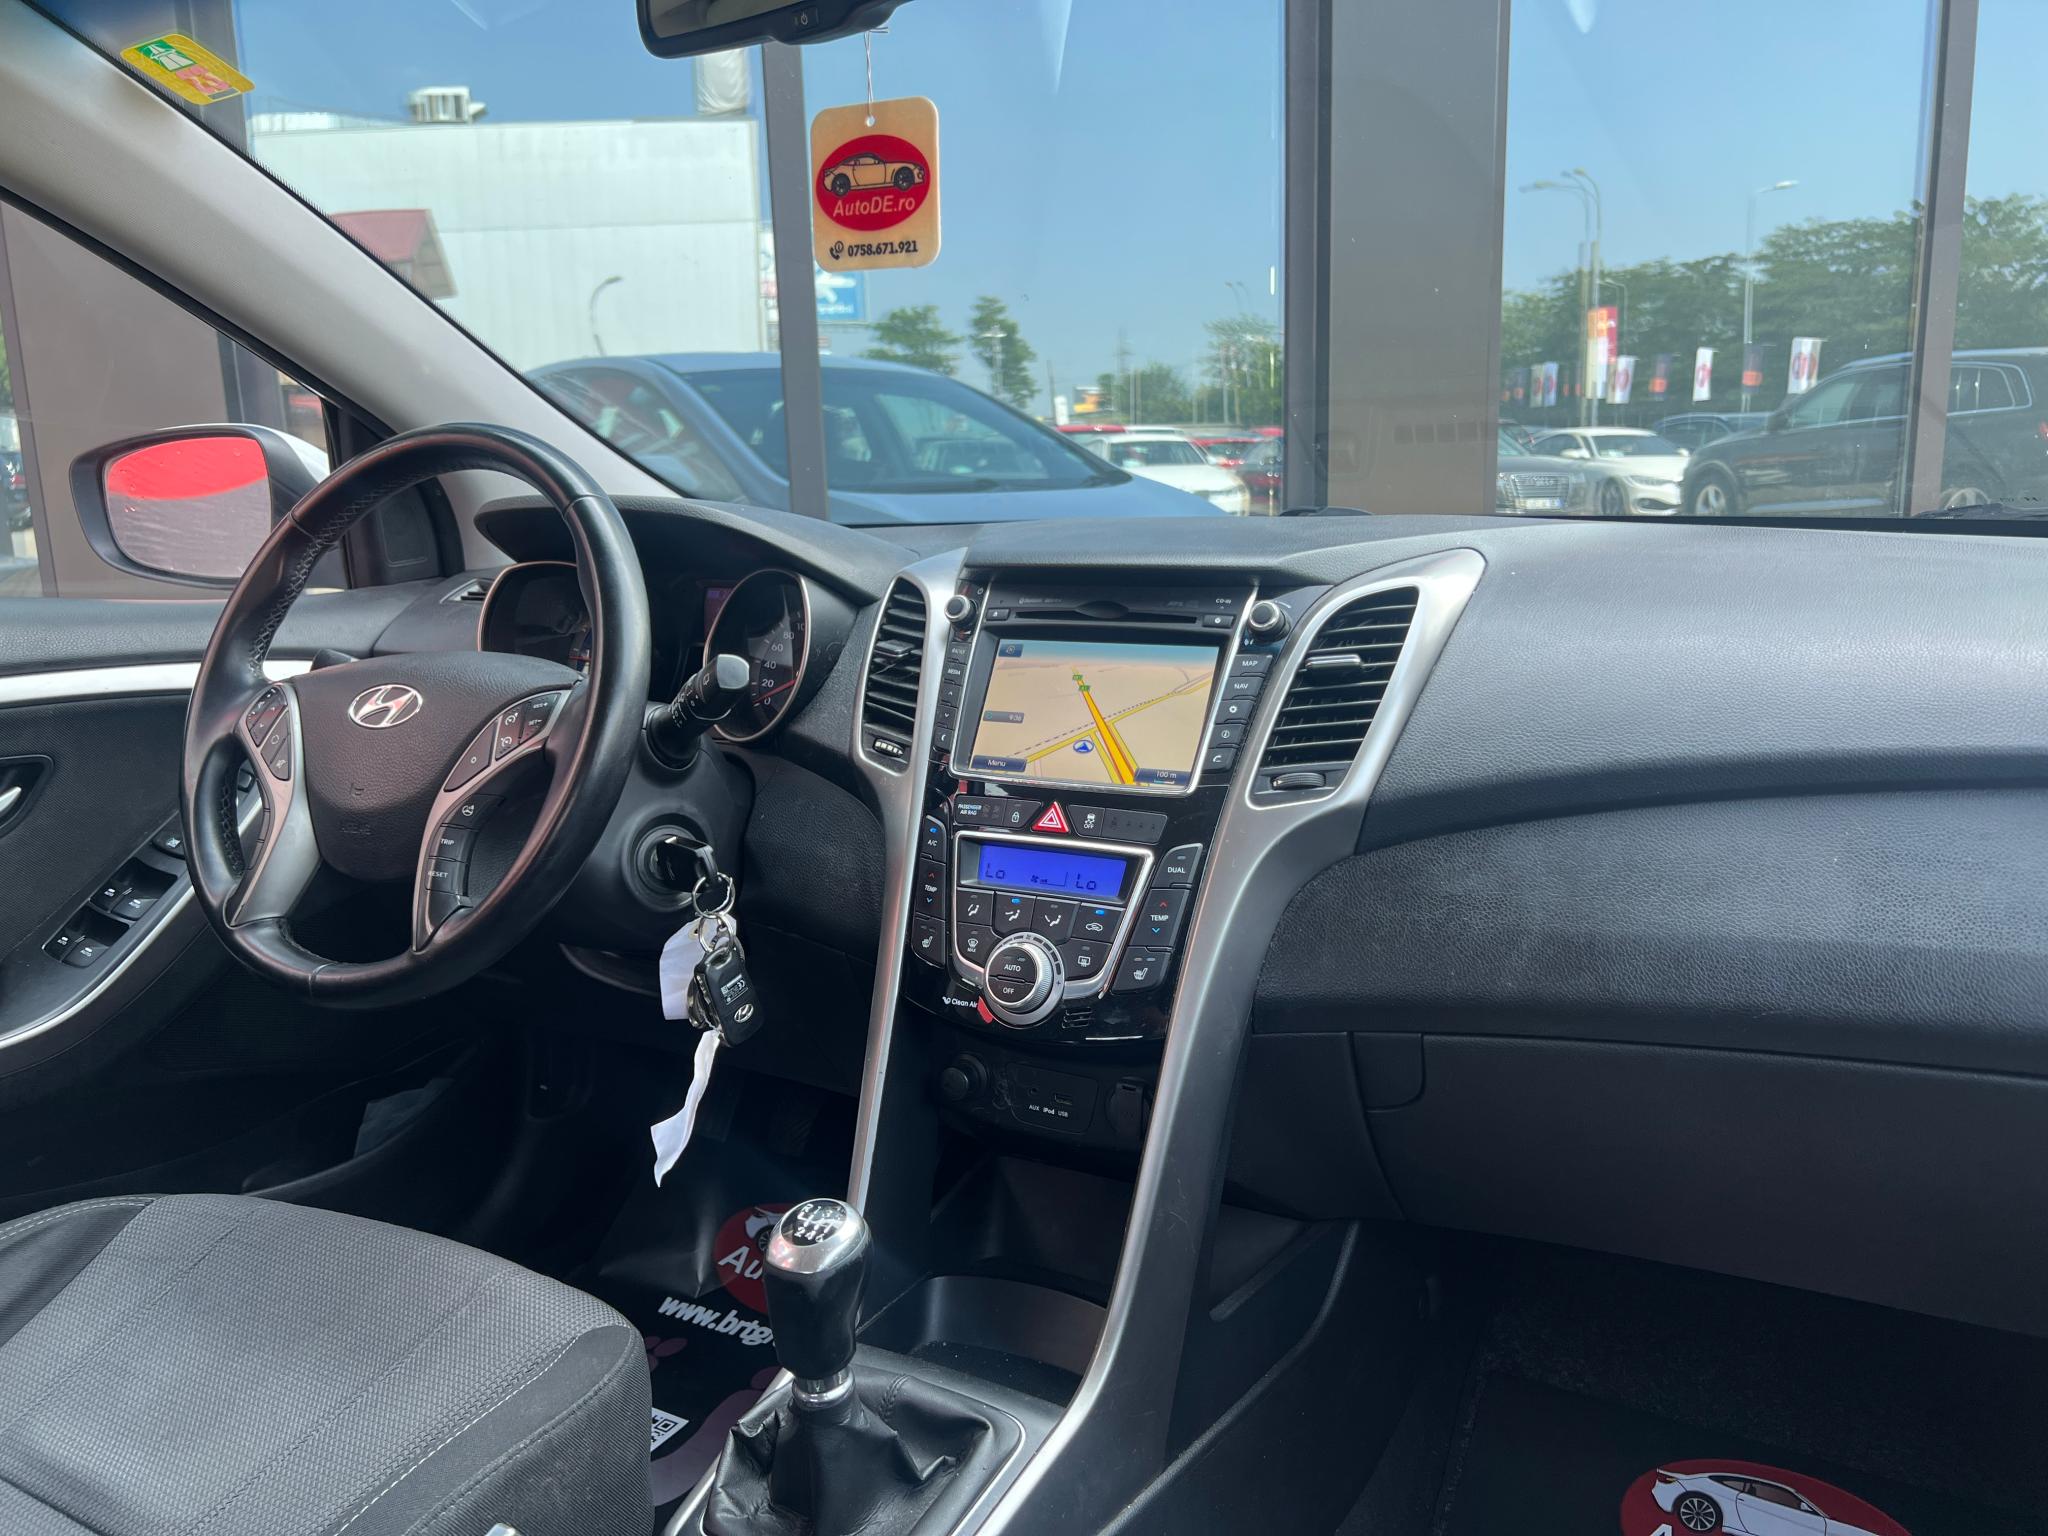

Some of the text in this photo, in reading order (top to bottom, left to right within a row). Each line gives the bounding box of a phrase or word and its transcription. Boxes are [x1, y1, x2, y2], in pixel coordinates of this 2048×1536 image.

[832, 195, 916, 217] AutoDE.ro
[847, 240, 918, 257] 0758.671.921
[783, 631, 795, 640] 80
[771, 643, 784, 652] 60
[763, 660, 777, 669] 40
[761, 679, 775, 688] 20
[764, 697, 771, 705] 0
[987, 759, 1006, 768] Menu
[958, 803, 982, 811] PASSENGER
[441, 838, 455, 846] TRIP
[927, 839, 938, 847] A/C
[985, 863, 1006, 880] Lo
[1167, 866, 1186, 874] DUAL
[1075, 873, 1097, 890] Lo
[924, 884, 938, 893] TEMP
[1150, 914, 1169, 922] TEMP
[1003, 963, 1022, 973] AUTO
[1002, 987, 1015, 995] OFF
[951, 999, 978, 1008] Clean Air
[1042, 1106, 1055, 1115] iPod
[1057, 1110, 1069, 1118] USB
[794, 1226, 806, 1238] 2
